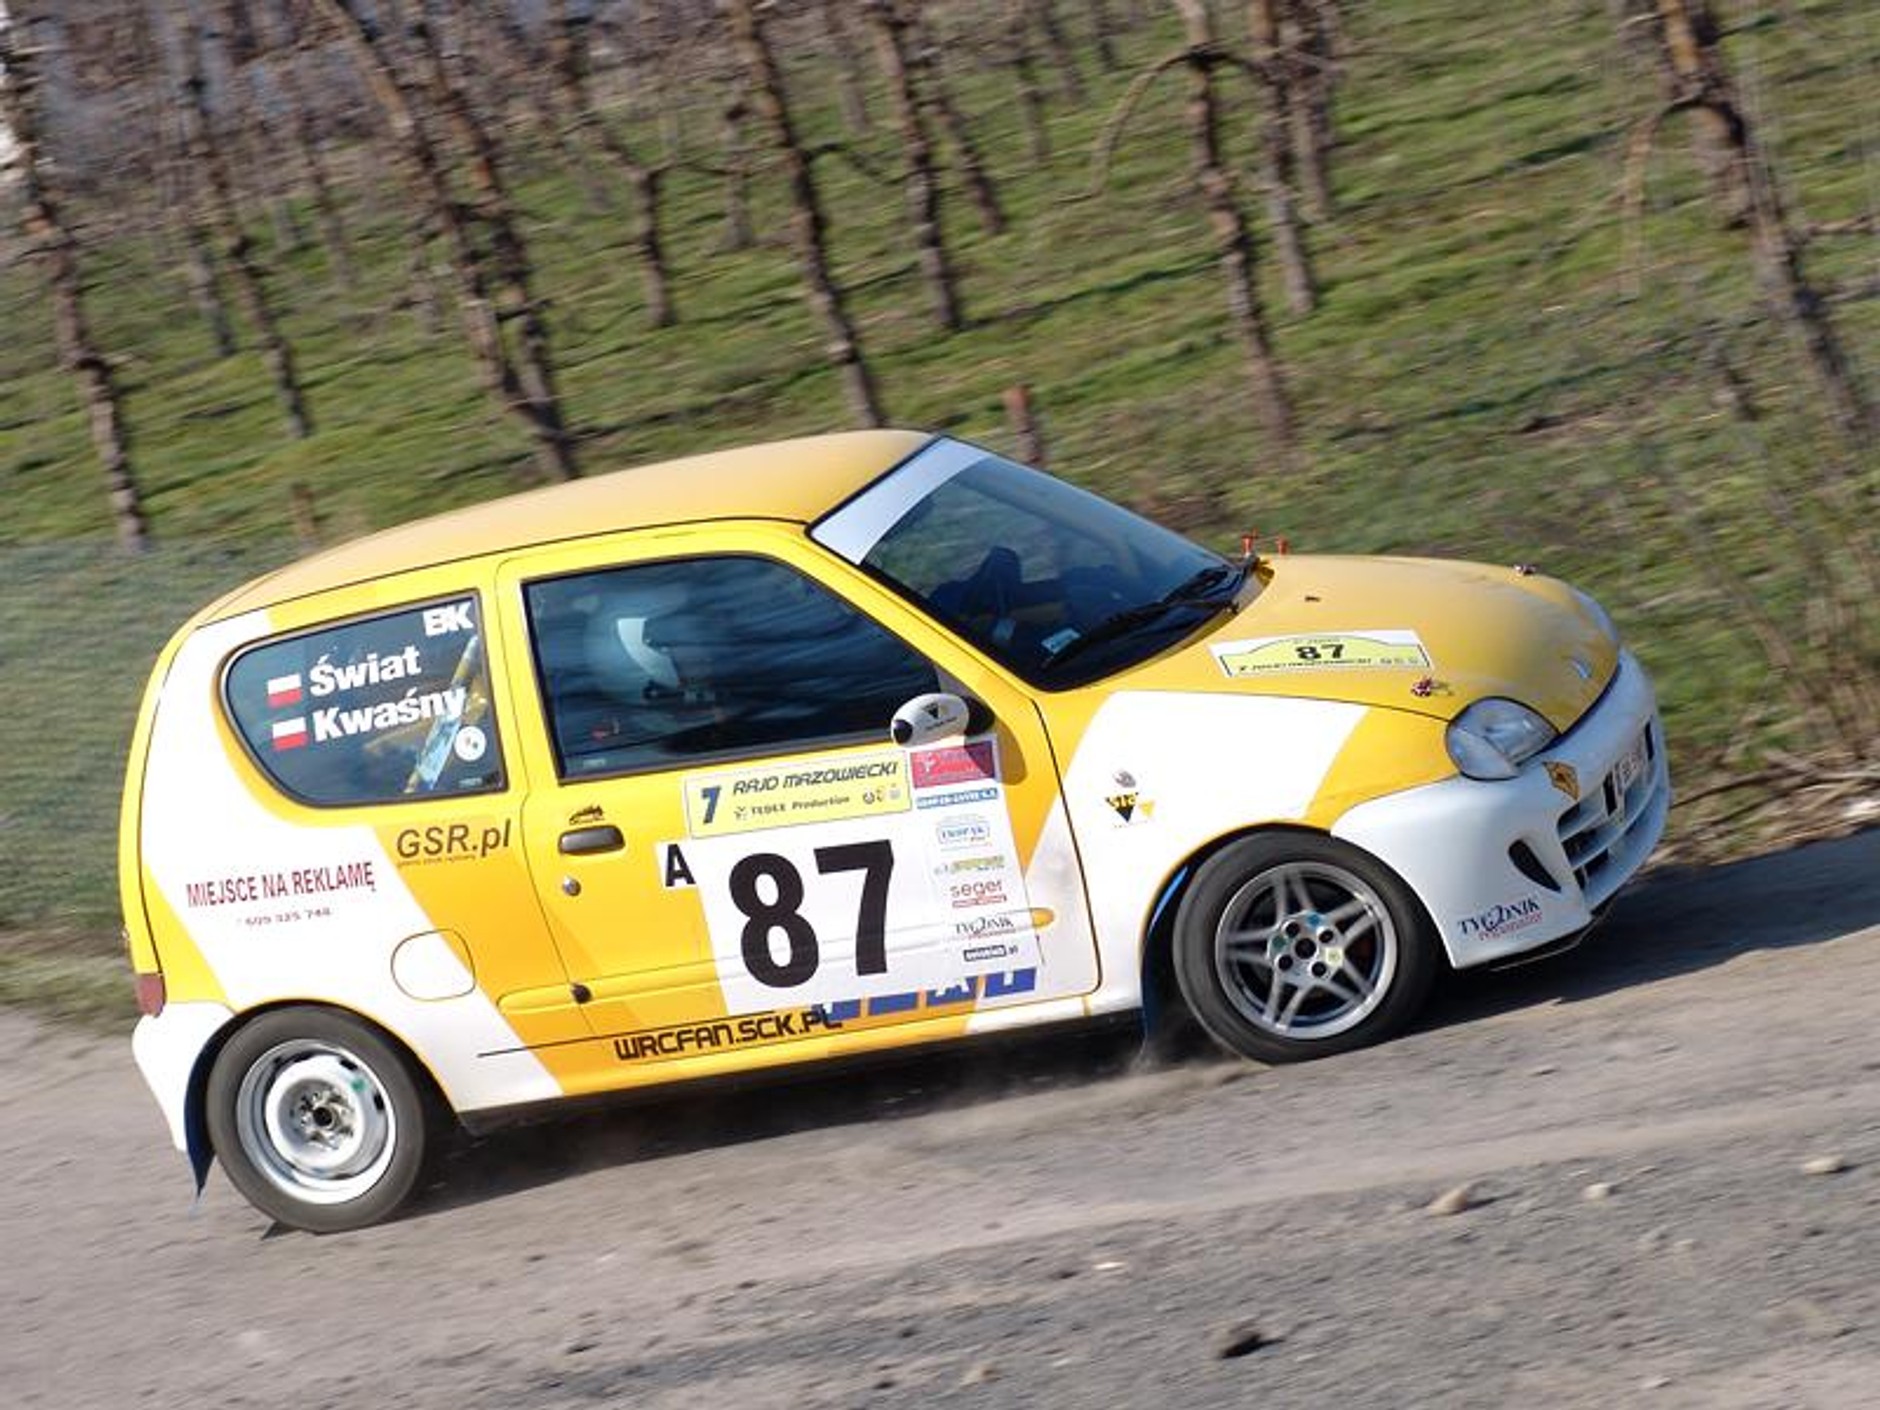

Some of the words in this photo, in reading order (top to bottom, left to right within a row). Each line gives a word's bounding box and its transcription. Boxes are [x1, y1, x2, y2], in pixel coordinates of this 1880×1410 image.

[310, 645, 421, 696] Świat
[1295, 644, 1343, 660] 87
[313, 686, 467, 742] Kwaśny
[702, 785, 721, 824] 7
[783, 762, 898, 790] MAZOWIECKI
[396, 818, 511, 859] GSR.pl
[186, 877, 258, 908] MIEJSCE
[262, 873, 288, 899] NA
[291, 861, 376, 895] REKLAMĘ
[665, 843, 696, 887] A
[728, 839, 894, 988] 87
[614, 1005, 842, 1061] WRCFAN.SCK.PL
